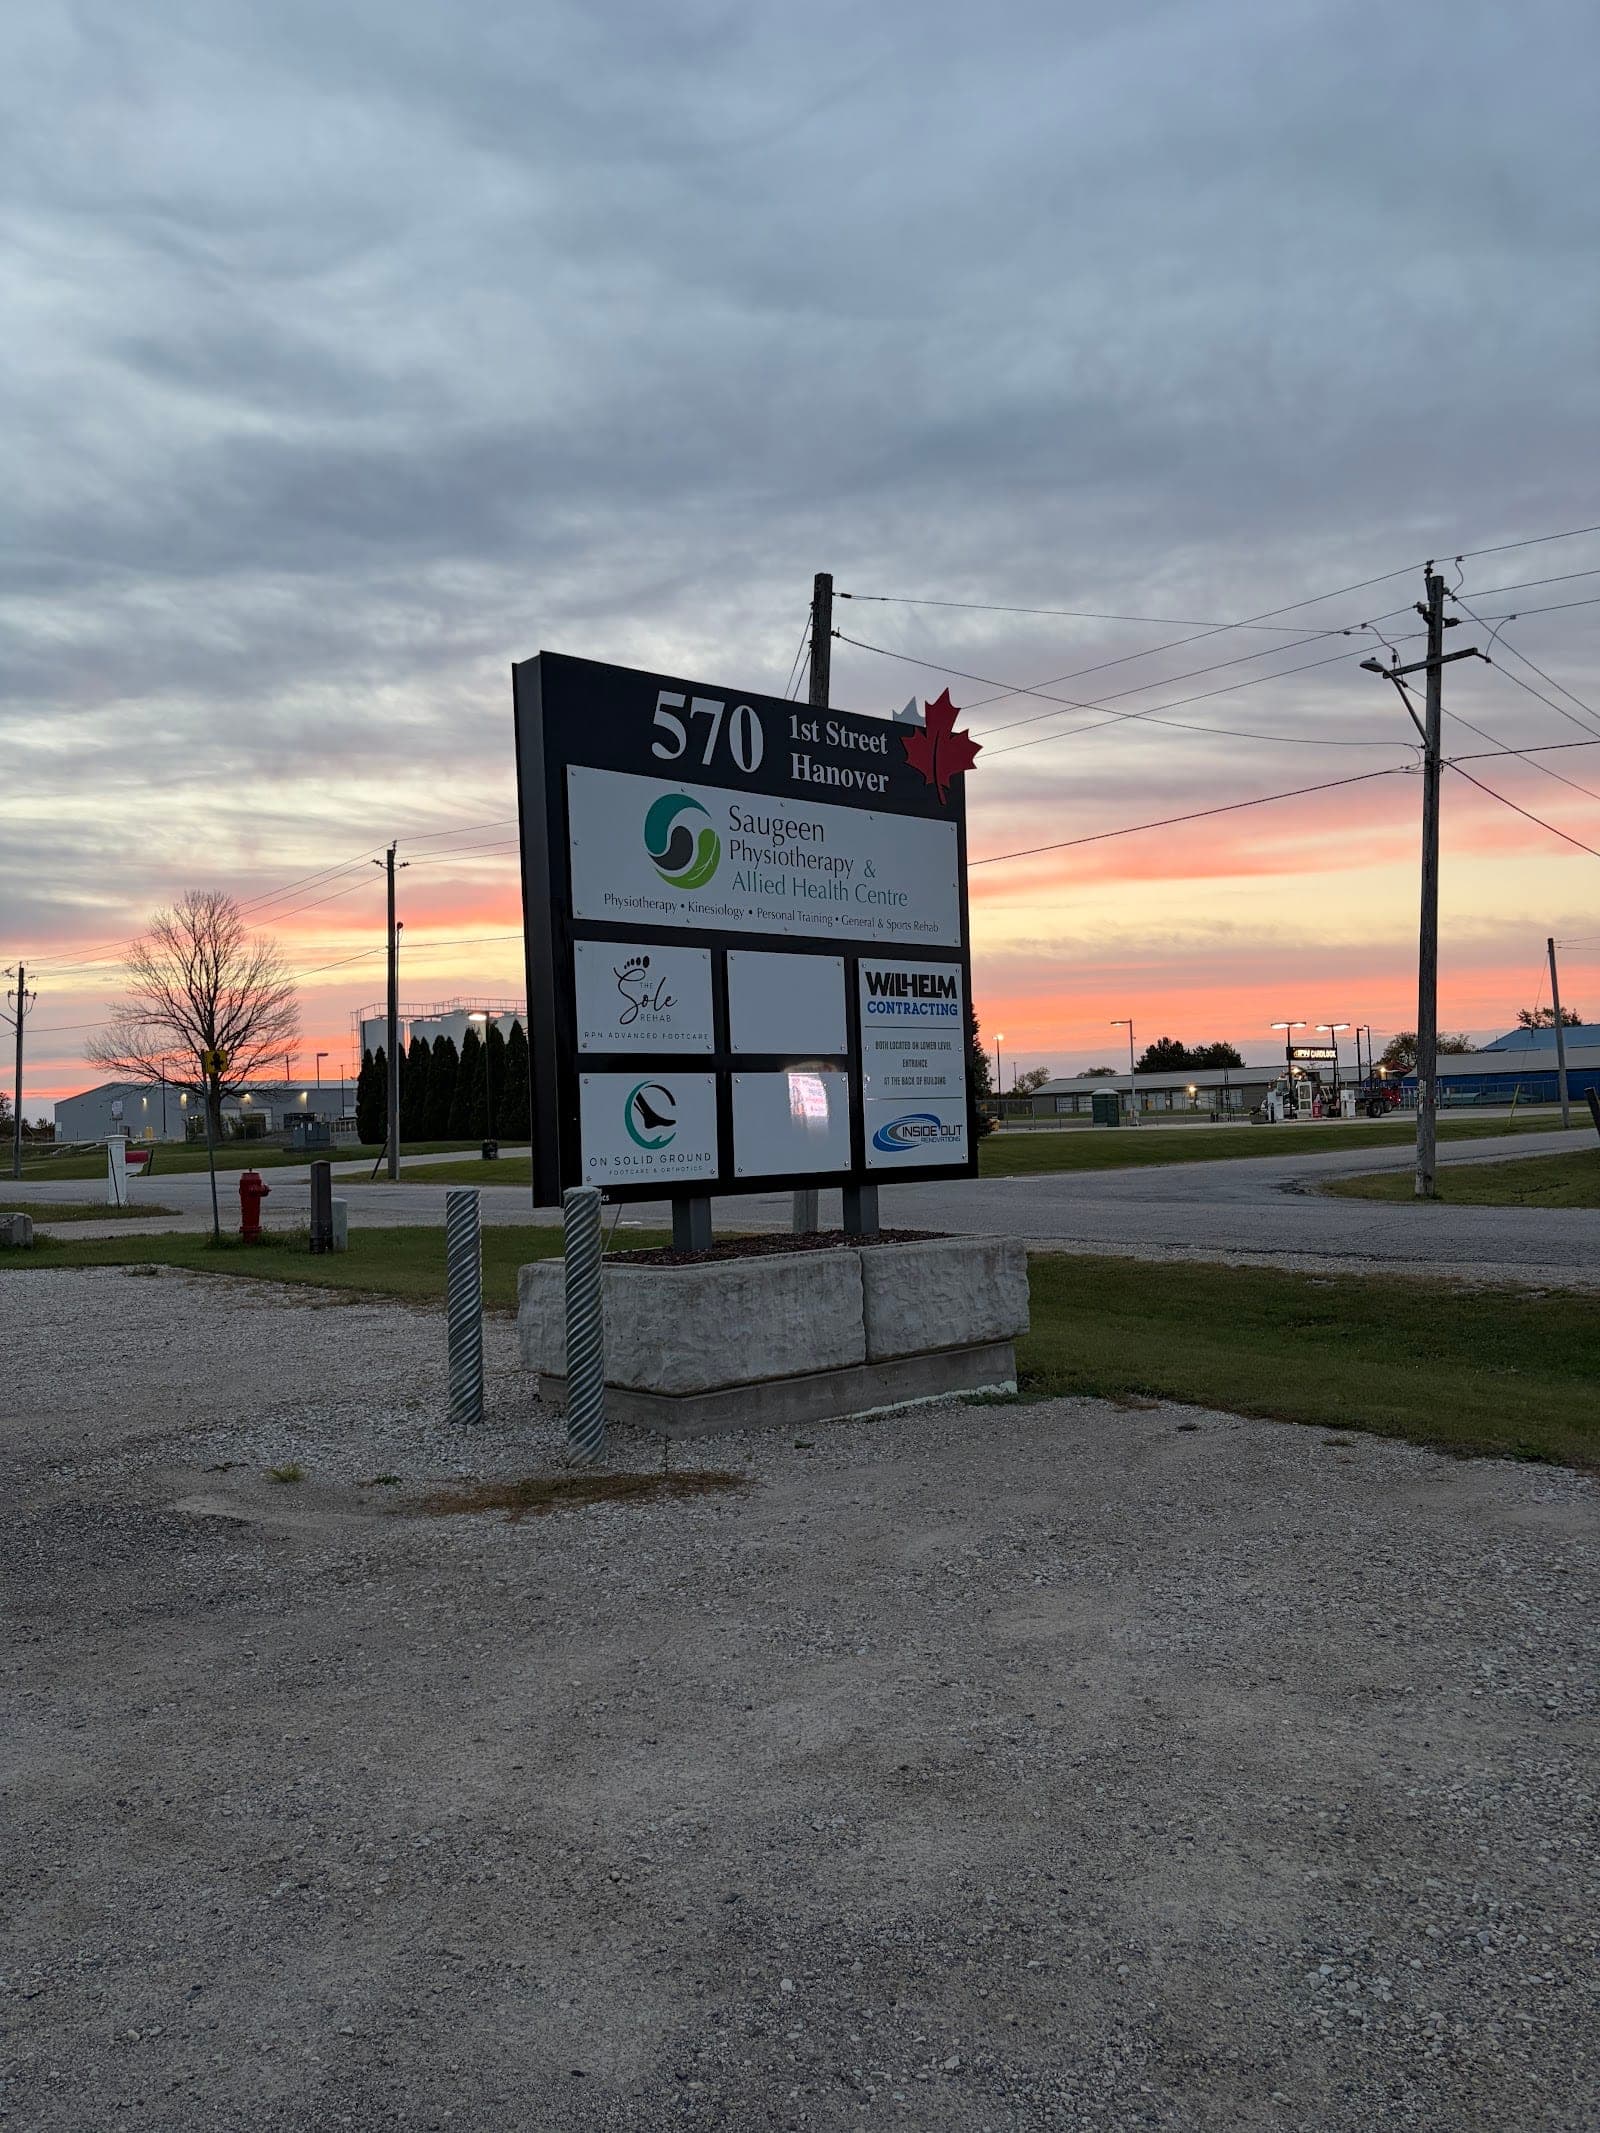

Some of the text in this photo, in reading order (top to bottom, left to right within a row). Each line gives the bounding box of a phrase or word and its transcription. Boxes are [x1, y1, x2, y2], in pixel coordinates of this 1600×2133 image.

[651, 690, 764, 773] 570
[788, 714, 888, 755] 1st Street
[790, 752, 889, 793] Hanover
[729, 805, 824, 847] Saugeen
[730, 839, 876, 879] Physiotherapy &
[732, 870, 908, 907] Allied Health Centre
[604, 892, 939, 933] Physiotherapy Kinesiology Personal Training General & Sports Rehab
[613, 966, 678, 1025] Sole
[864, 971, 958, 999] WILHELM
[640, 1013, 672, 1023] REHAB
[867, 1001, 958, 1016] CONTRACTING
[584, 1031, 603, 1039] RPN
[608, 1032, 658, 1040] ADVANCED
[889, 1041, 911, 1050] LOCATED
[920, 1041, 937, 1051] LOWER
[937, 1041, 952, 1051] LEVEL
[902, 1059, 928, 1068] ENTRANCE
[891, 1076, 901, 1086] THE
[901, 1076, 915, 1086] BACK
[923, 1076, 947, 1086] BUILDING
[902, 1124, 962, 1137] INSIDE OUT
[589, 1152, 711, 1167] ON SOLID GROUND
[609, 1167, 649, 1176] FOOTCARE
